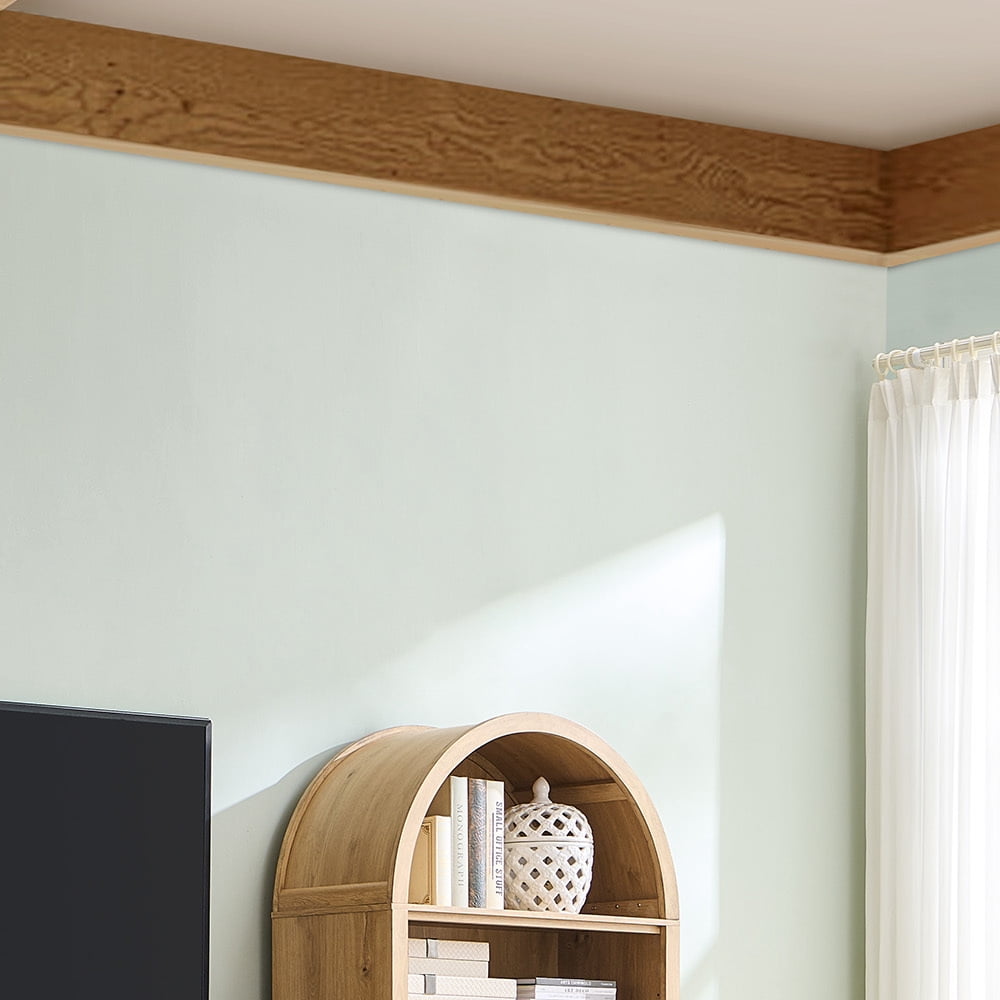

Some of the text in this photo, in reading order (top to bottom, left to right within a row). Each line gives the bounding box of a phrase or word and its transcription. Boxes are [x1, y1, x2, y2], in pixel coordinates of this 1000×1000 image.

[456, 804, 464, 886] MONOGRAPH
[495, 801, 503, 896] SMALL OFFICE STUFF
